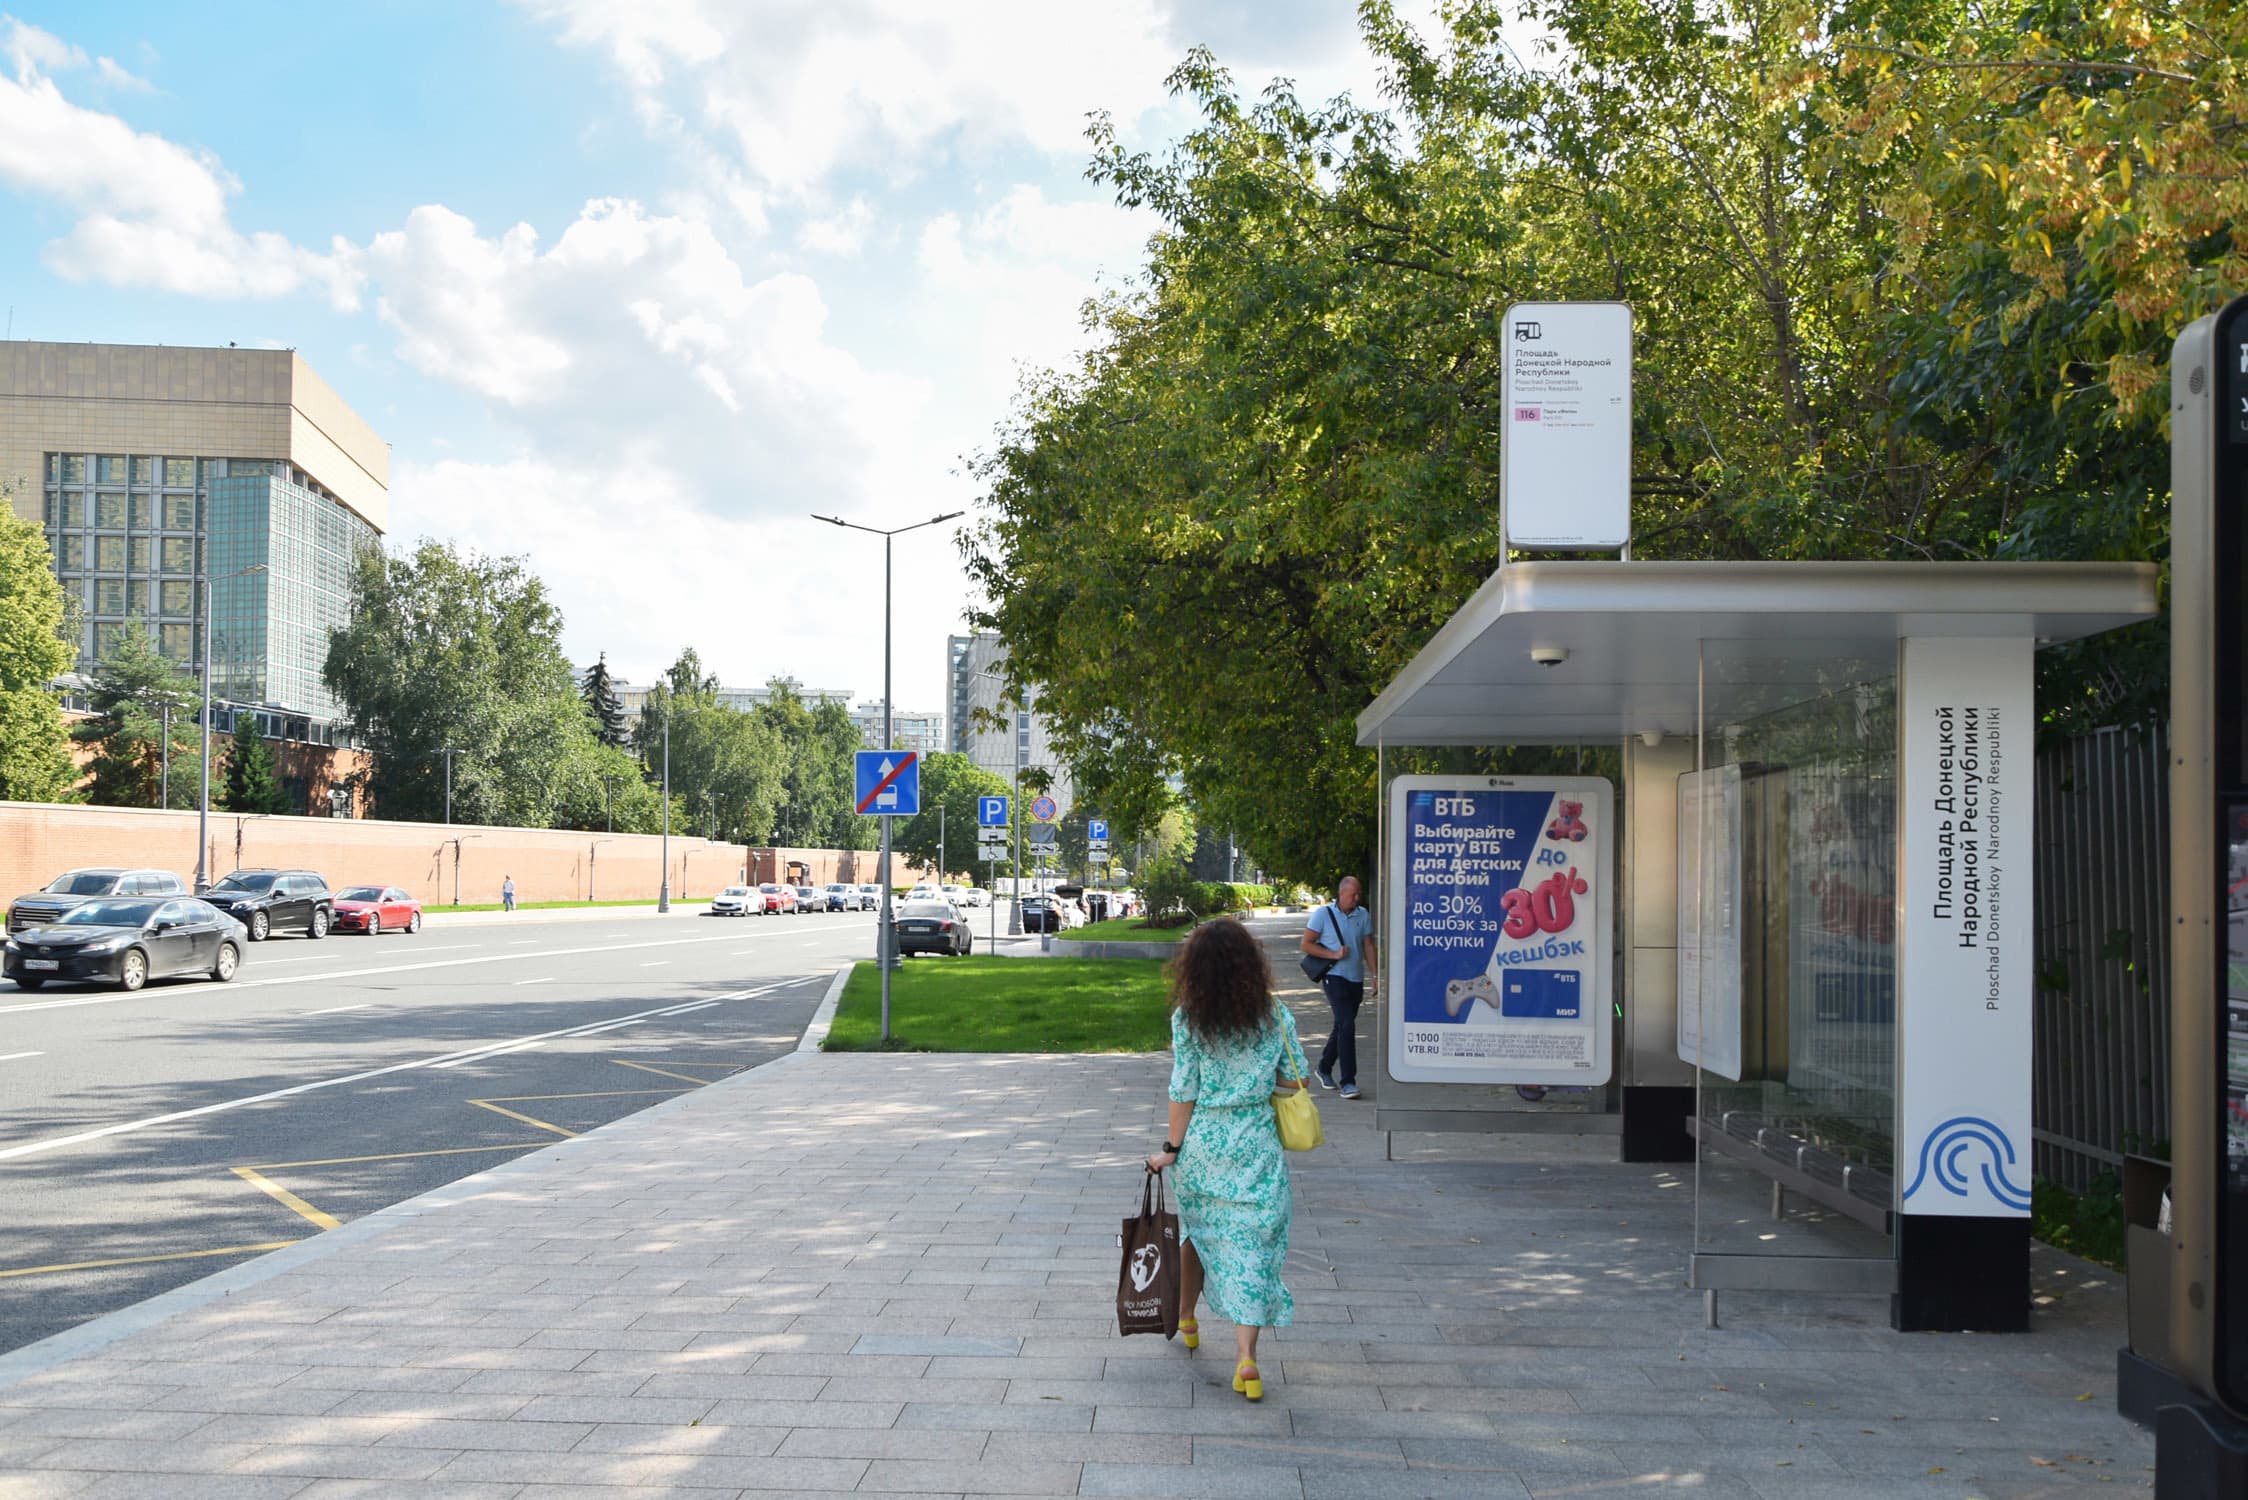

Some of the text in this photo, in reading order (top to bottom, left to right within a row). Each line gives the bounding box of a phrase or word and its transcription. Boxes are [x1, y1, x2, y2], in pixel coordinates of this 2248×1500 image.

[1515, 349, 1559, 358] Площадь
[1515, 358, 1611, 368] Донецкой Народной
[1515, 368, 1570, 377] Республики
[1520, 410, 1536, 419] 116
[987, 800, 1002, 822] P
[1434, 798, 1476, 816] ВТБ
[1934, 706, 1956, 919] Площадь Донецкой
[1094, 823, 1105, 838] P
[1414, 824, 1516, 841] Выбирайте
[1959, 707, 1982, 948] Народной Республики
[1414, 841, 1501, 857] карту ВТБ
[1536, 847, 1568, 866] до
[1413, 858, 1522, 872] для детских
[1986, 707, 2002, 1011] Ploschad Donetskoy Narodnoy Respubliki
[1413, 870, 1490, 886] пособий
[1412, 895, 1483, 916] до 30%
[1501, 866, 1589, 940] 30%
[1413, 915, 1498, 931] кешбэк за
[1413, 936, 1485, 951] покупки
[1496, 936, 1585, 967] кешбэк
[1560, 974, 1576, 983] ВТБ
[1556, 1008, 1577, 1016] МИР
[1416, 1033, 1440, 1042] 1000
[1408, 1045, 1440, 1054] VTB.RU
